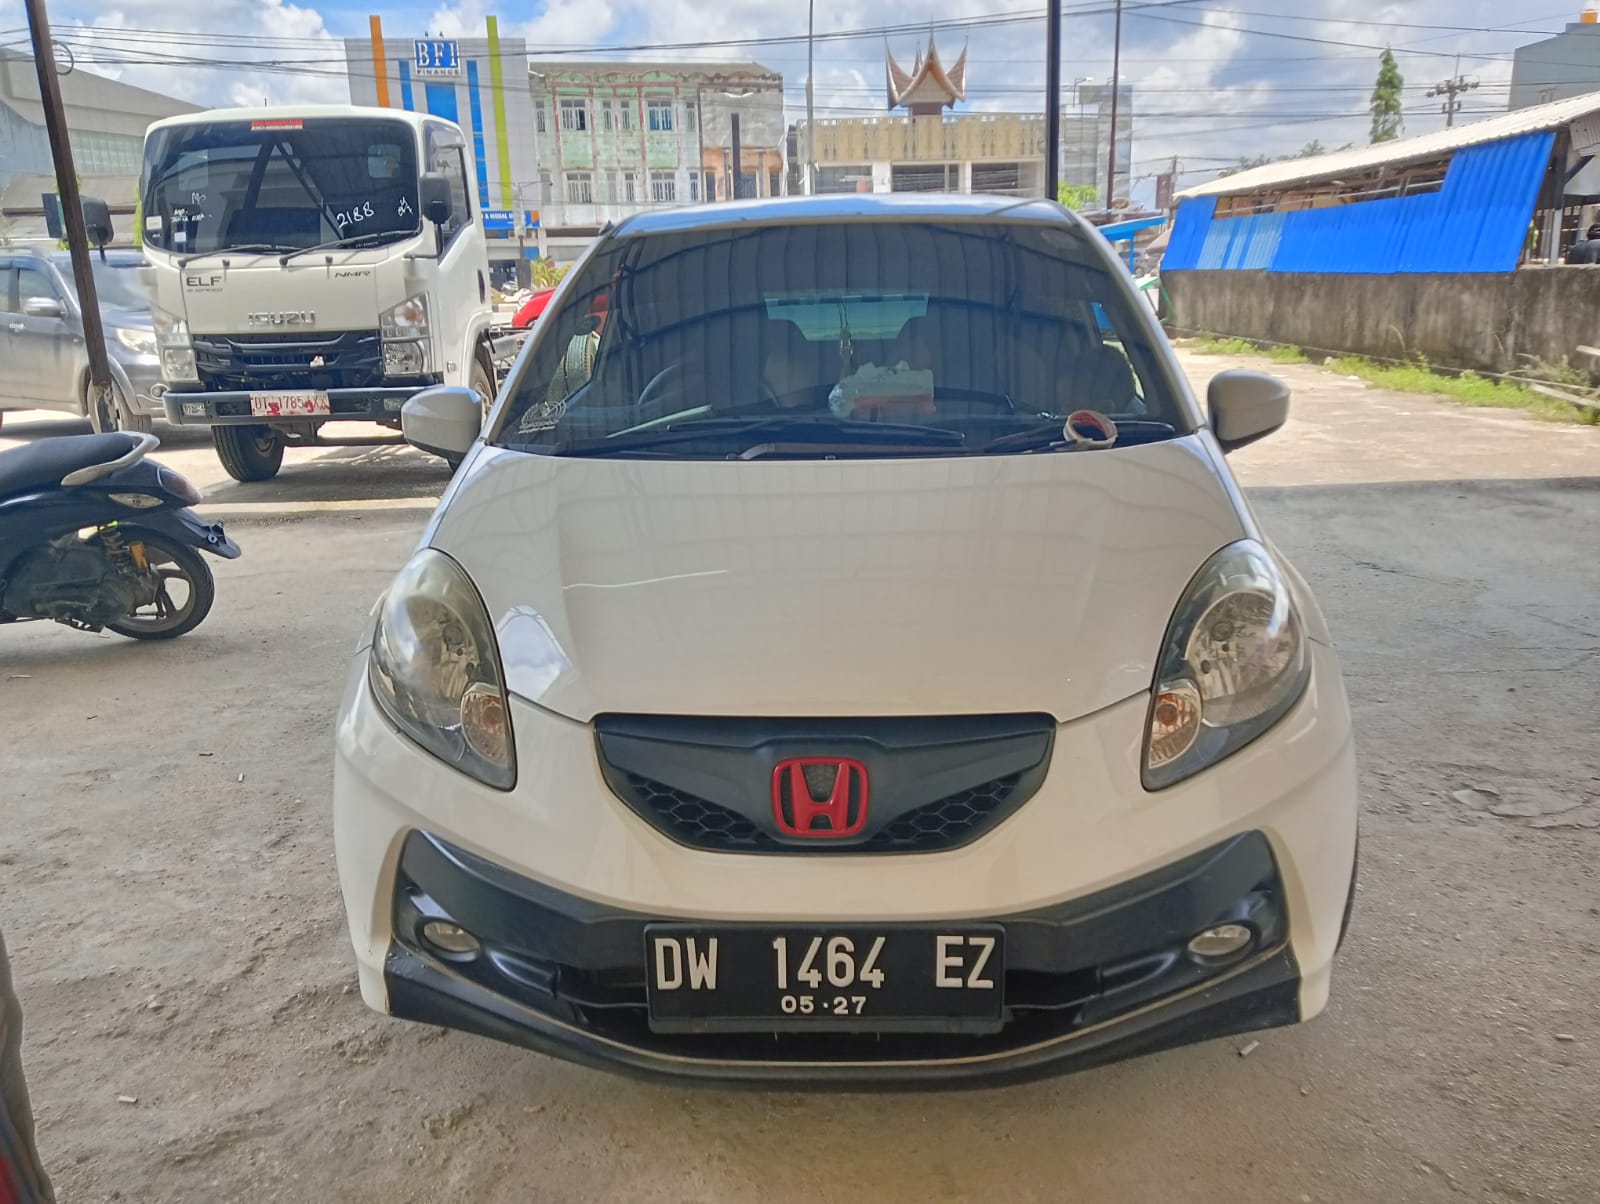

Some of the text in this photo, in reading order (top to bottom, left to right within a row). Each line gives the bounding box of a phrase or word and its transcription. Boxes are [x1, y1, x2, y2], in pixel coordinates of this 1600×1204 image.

[417, 42, 457, 67] BFI
[336, 201, 375, 229] 2188
[186, 276, 222, 286] ELF
[248, 310, 316, 327] ISUZU
[654, 935, 996, 990] DW 1464 EZ
